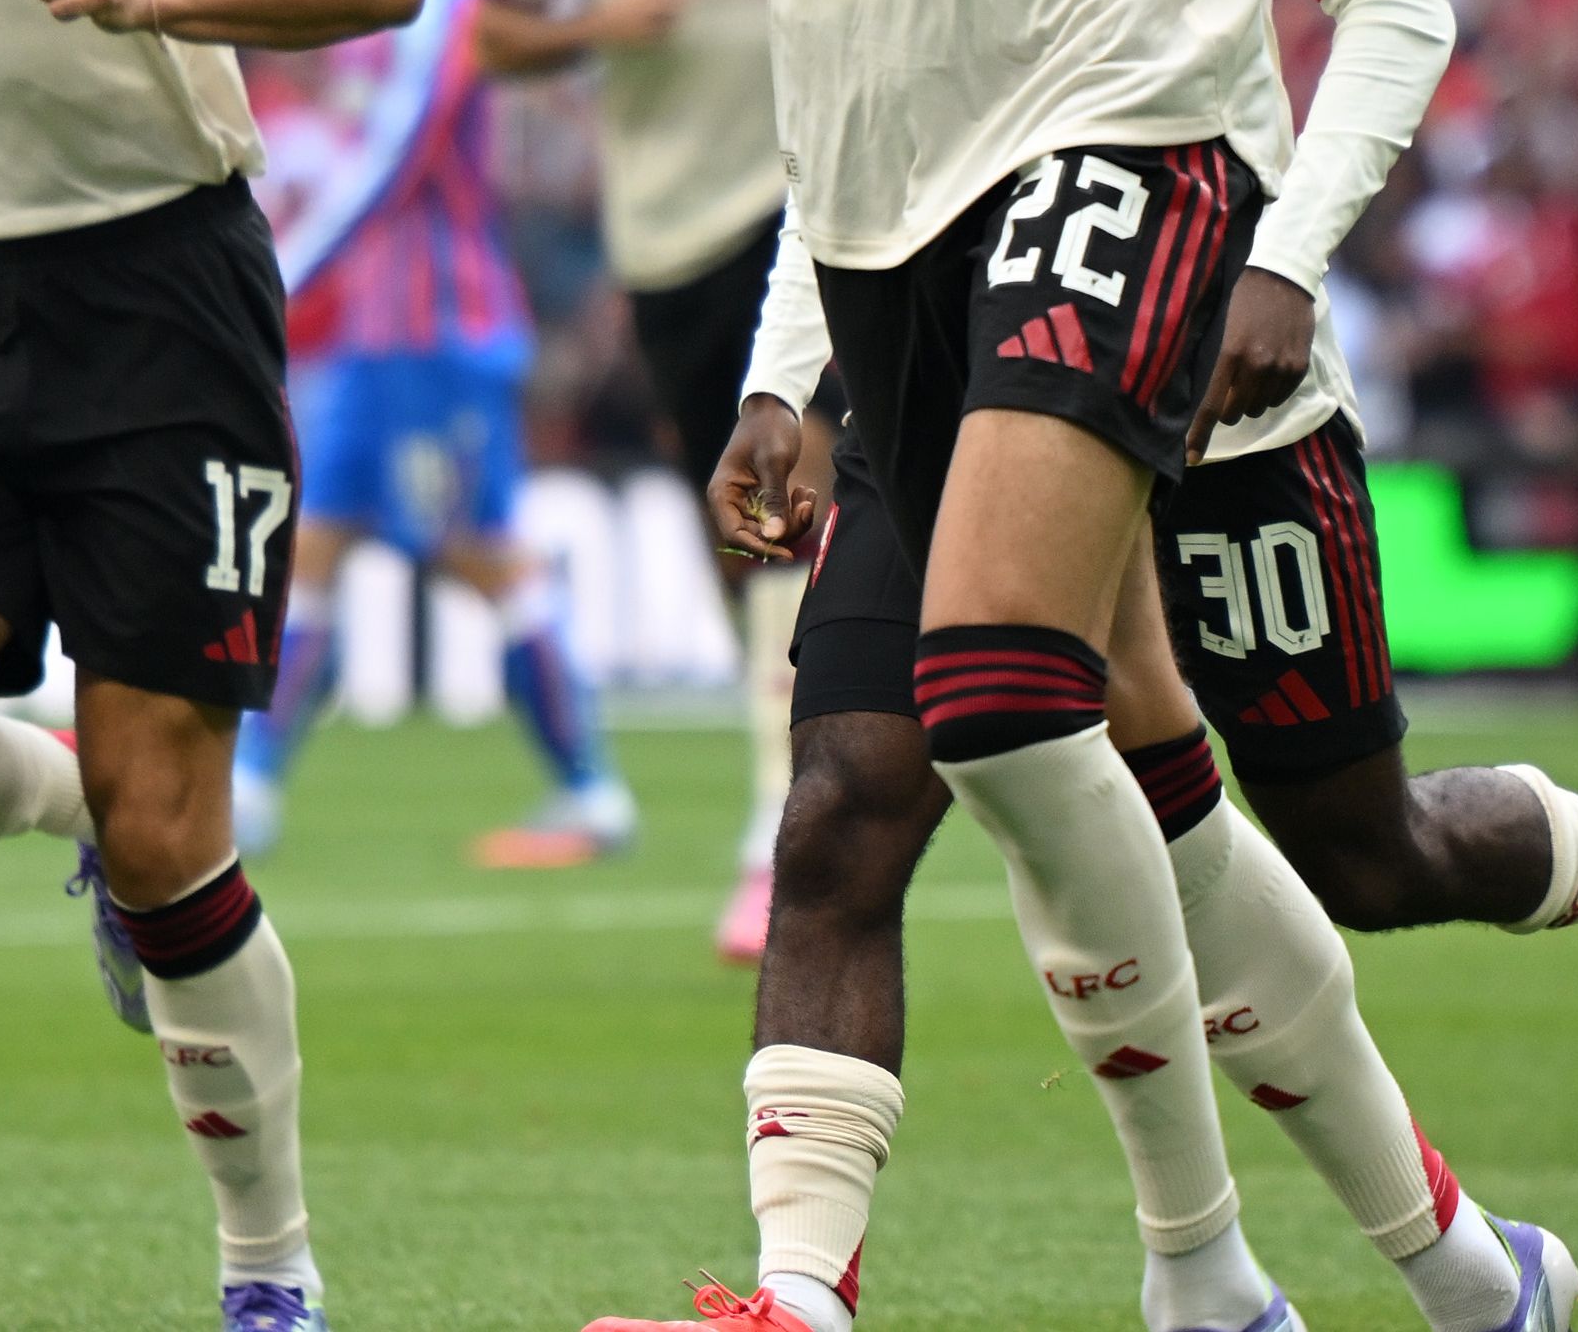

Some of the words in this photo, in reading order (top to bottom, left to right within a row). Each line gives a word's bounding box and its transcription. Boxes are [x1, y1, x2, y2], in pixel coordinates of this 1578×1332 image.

[987, 153, 1150, 307] 22
[205, 460, 292, 596] 17
[1176, 521, 1331, 659] 30
[1044, 958, 1140, 999] LFC
